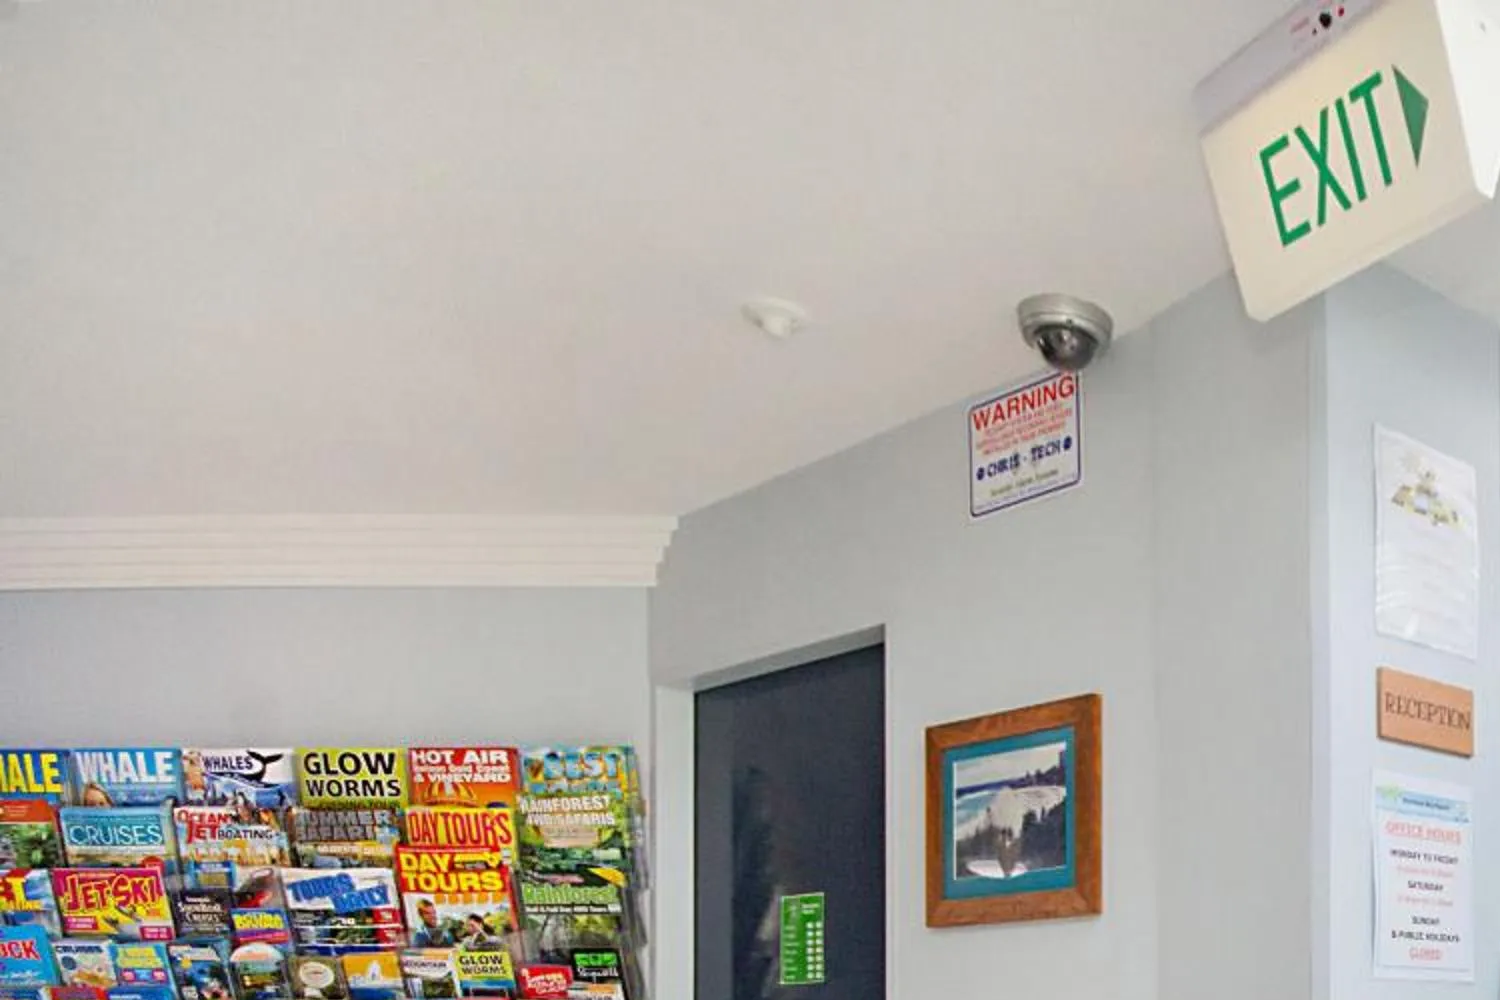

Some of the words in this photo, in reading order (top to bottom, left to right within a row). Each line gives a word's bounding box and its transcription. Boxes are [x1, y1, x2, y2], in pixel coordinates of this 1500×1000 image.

[1259, 71, 1393, 247] EXIT
[972, 376, 1074, 430] WARNING
[1384, 692, 1470, 730] RECEPTION
[75, 751, 177, 783] WHALE
[202, 755, 253, 770] WHALES
[303, 752, 396, 775] GLOW
[412, 750, 454, 764] HOT
[463, 750, 508, 764] AIR
[428, 772, 511, 782] VINEYARD
[306, 779, 401, 797] WORMS
[69, 825, 163, 845] CRUISES
[187, 824, 219, 844] JET
[218, 829, 273, 840] BOATING
[408, 810, 438, 843] DAY
[440, 810, 513, 849] TOURS
[401, 853, 450, 872] DAY
[65, 873, 110, 911] JET
[112, 874, 157, 908] SKI
[404, 872, 503, 892] TOURS
[459, 953, 502, 965] GLOW
[461, 966, 506, 975] WORMS
